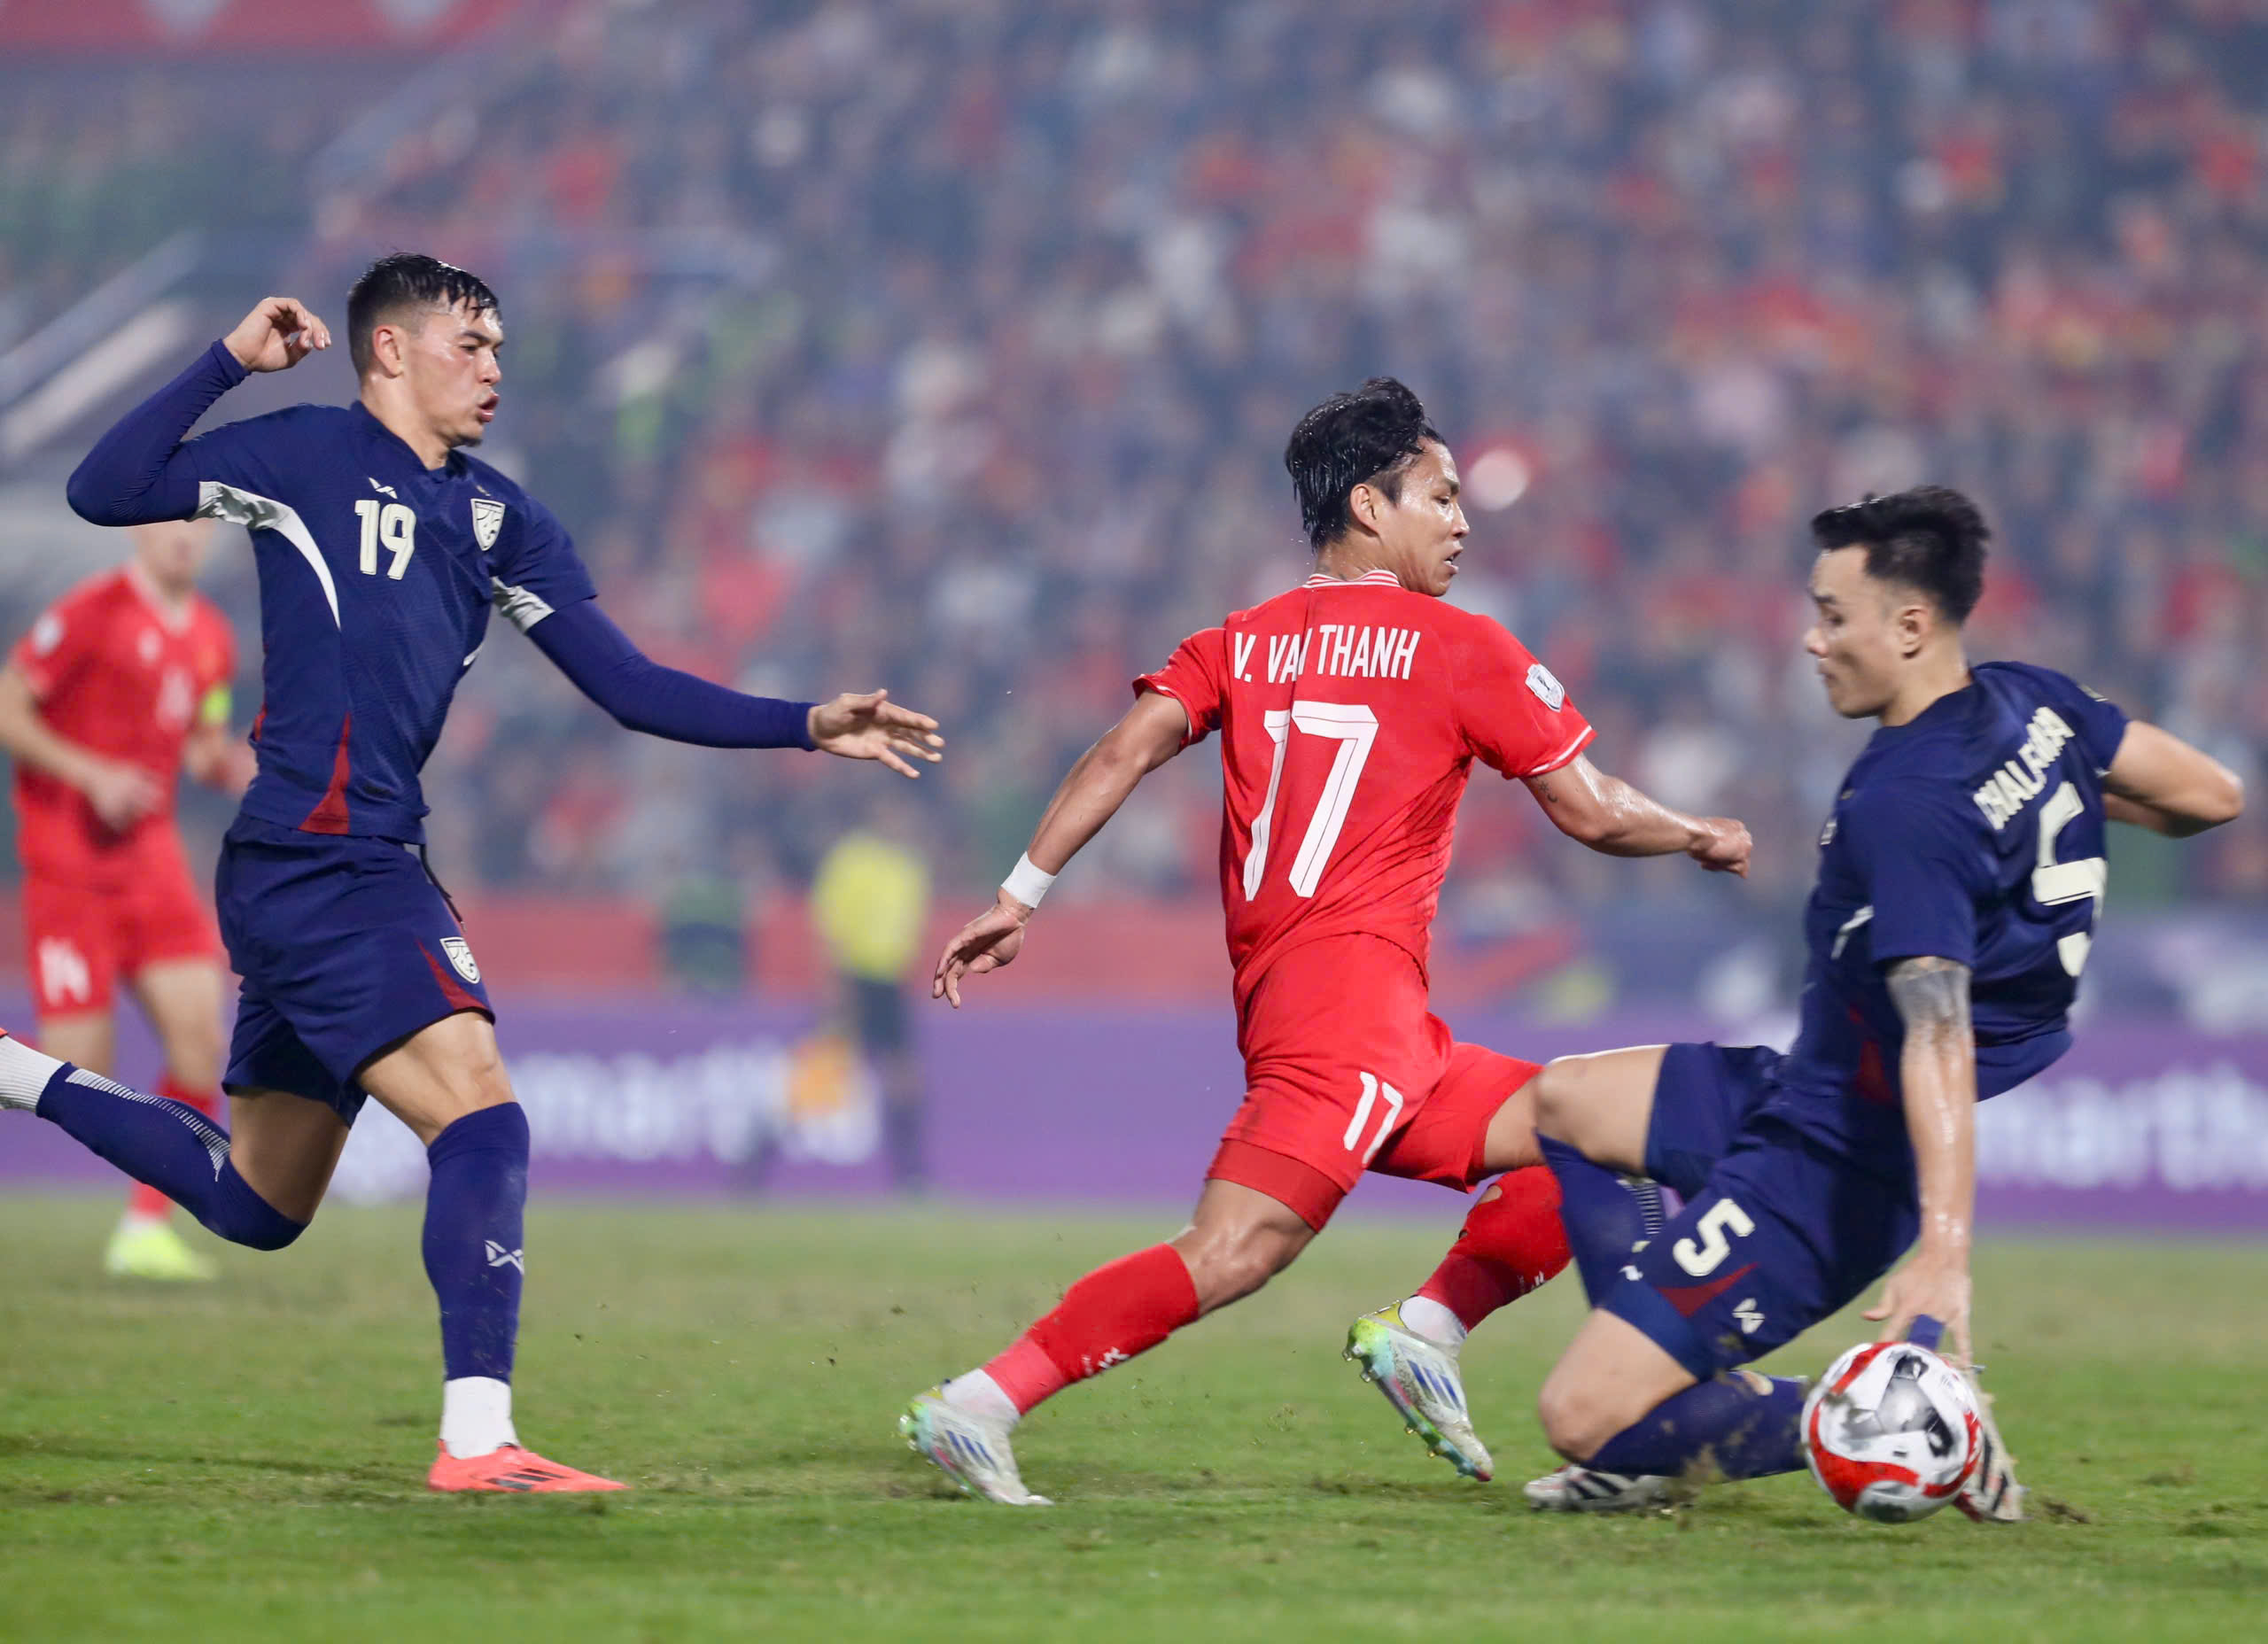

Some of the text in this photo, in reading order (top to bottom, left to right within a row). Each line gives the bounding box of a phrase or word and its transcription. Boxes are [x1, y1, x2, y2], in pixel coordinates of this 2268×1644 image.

[354, 500, 417, 580] 19
[1234, 632, 1257, 683] V.
[1317, 624, 1421, 680] THANH
[1243, 700, 1379, 902] 17
[2031, 780, 2108, 977] 5
[1342, 1071, 1404, 1168] 17
[1673, 1198, 1756, 1276] 5
